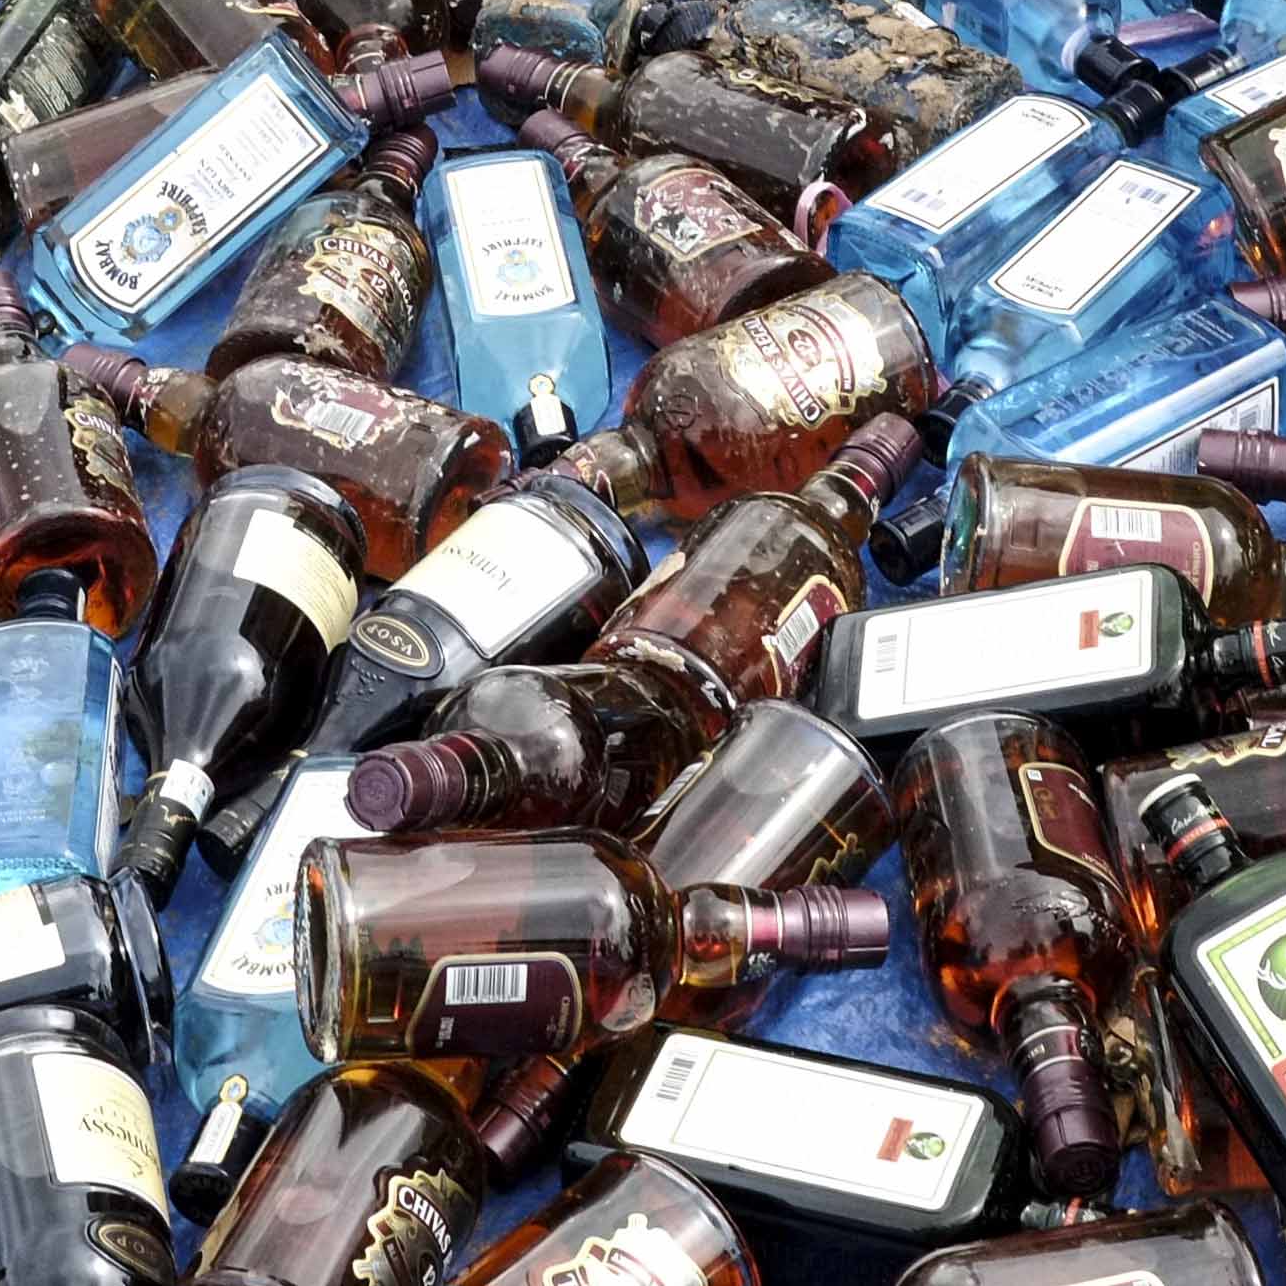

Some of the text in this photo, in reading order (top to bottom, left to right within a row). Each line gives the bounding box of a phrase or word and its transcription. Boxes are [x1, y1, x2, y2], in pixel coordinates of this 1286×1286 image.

[156, 180, 208, 237] SAPPHIRE
[95, 239, 142, 290] BOMBAY
[323, 238, 390, 269] CHIVAS
[369, 275, 386, 294] 12
[398, 1185, 450, 1258] CHIVAS
